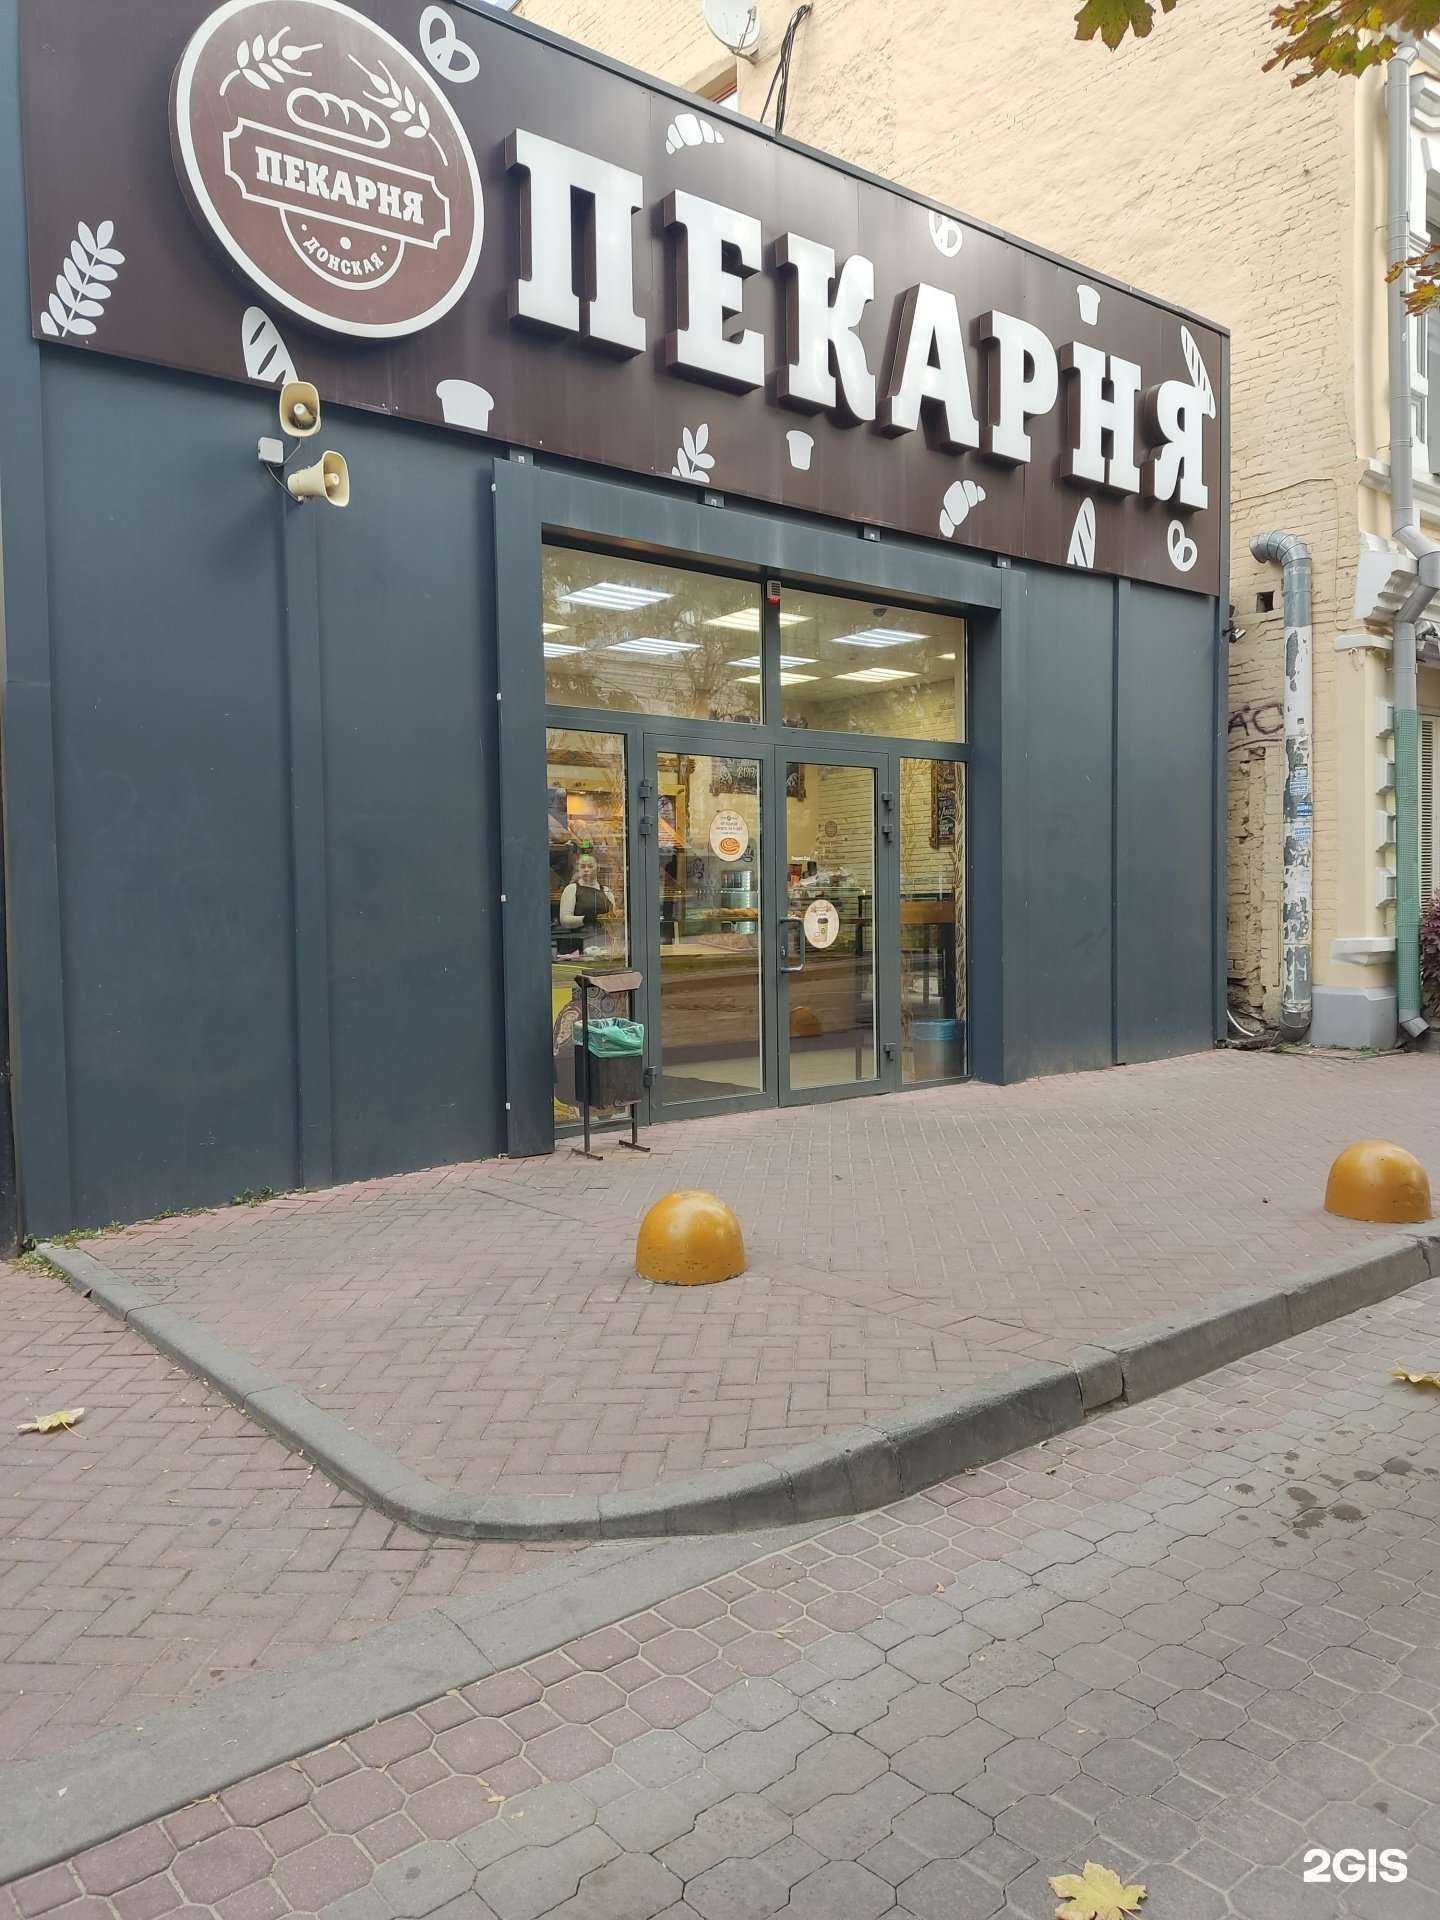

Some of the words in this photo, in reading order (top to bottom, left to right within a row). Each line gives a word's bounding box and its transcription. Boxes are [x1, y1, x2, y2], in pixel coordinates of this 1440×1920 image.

[255, 146, 424, 225] ПЕКАРНЯ
[302, 236, 384, 276] ДОНСКАЯ
[508, 128, 1209, 511] ПЕКАРНЯ
